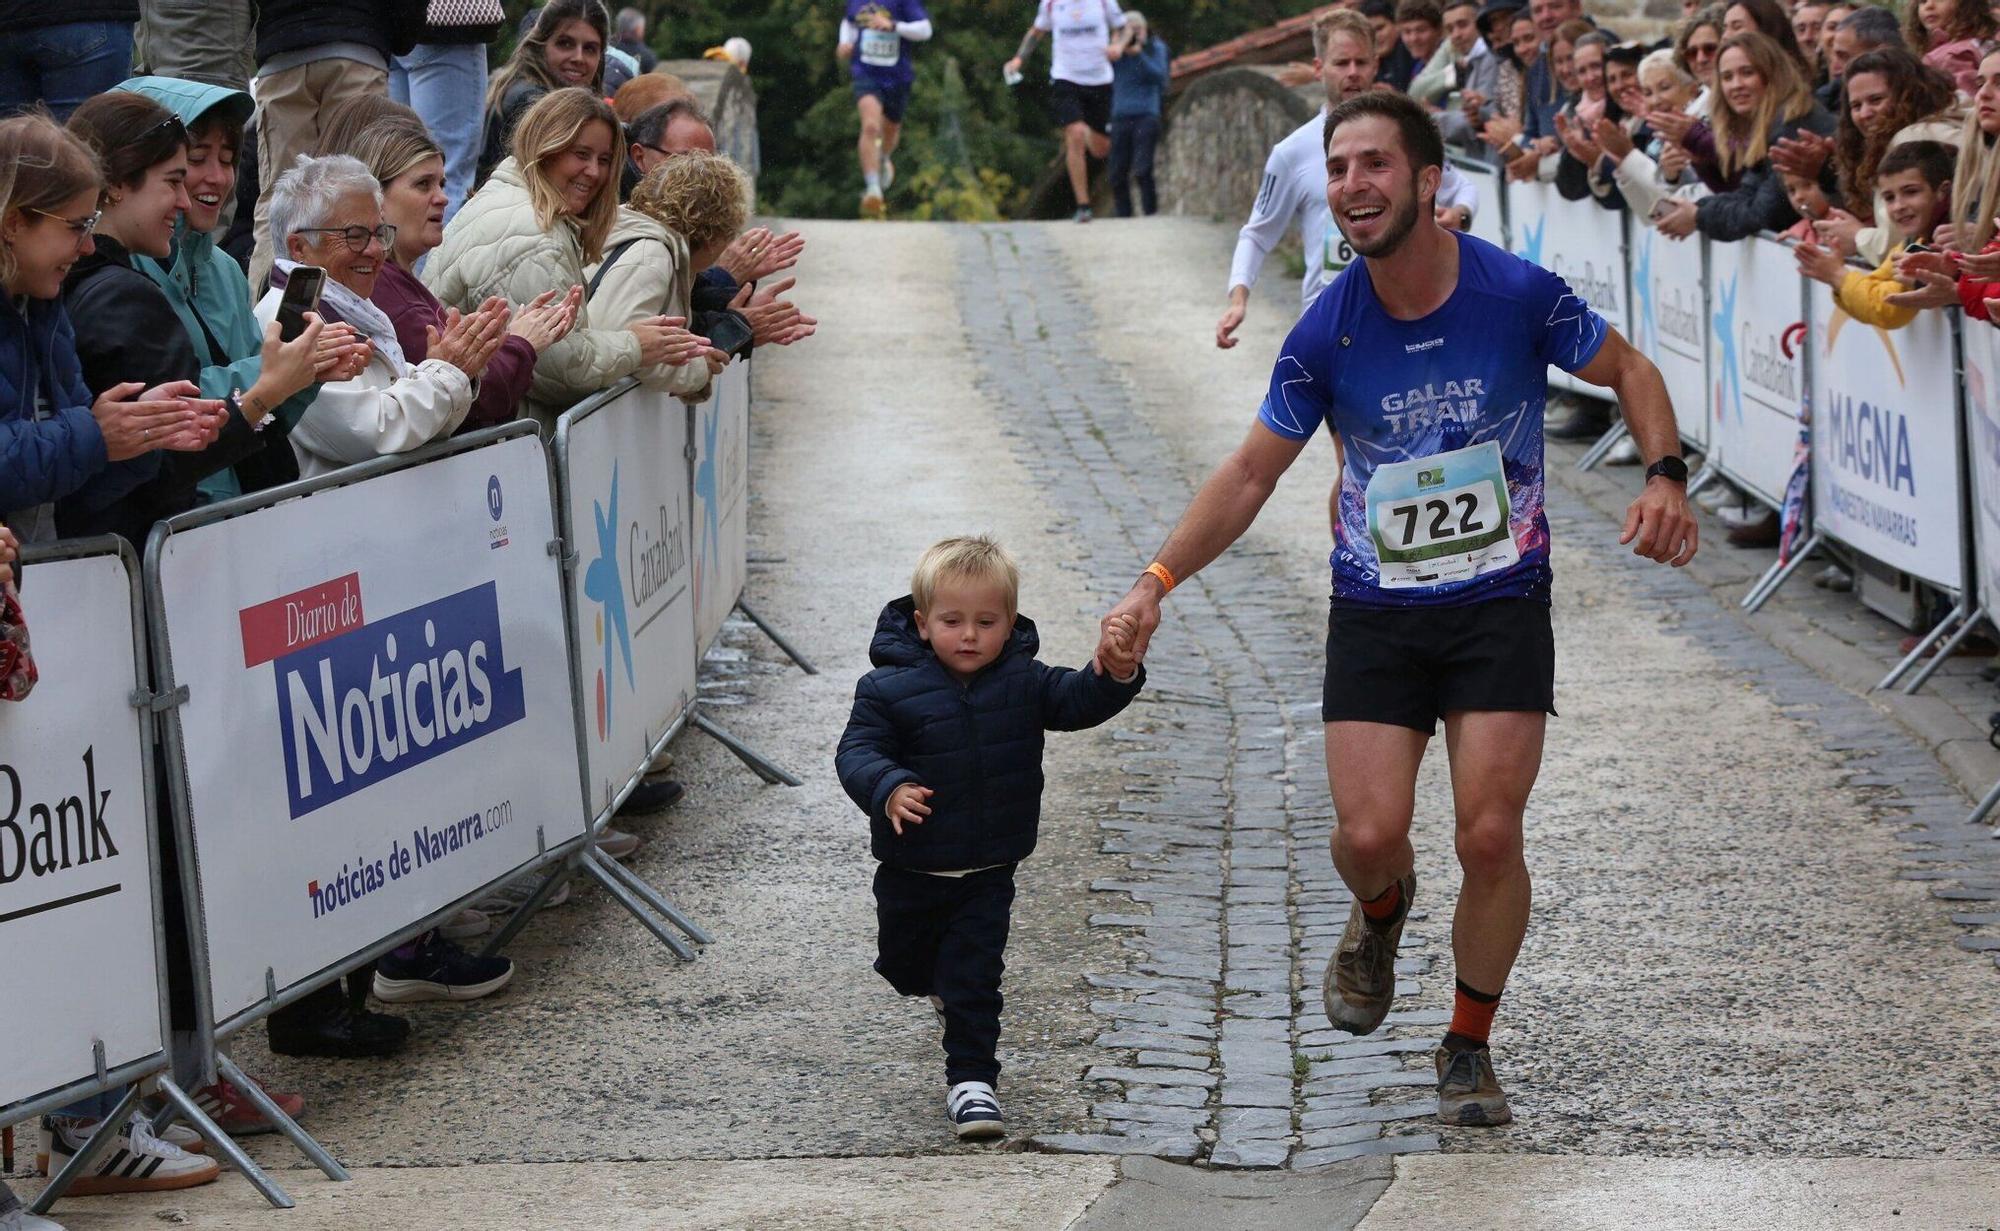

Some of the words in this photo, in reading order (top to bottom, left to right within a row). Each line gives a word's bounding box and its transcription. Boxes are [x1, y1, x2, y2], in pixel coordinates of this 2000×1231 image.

[1552, 253, 1618, 313] ixaBank
[1381, 378, 1486, 412] GALAR
[1382, 399, 1485, 435] TRAIL
[1829, 389, 1916, 498] MAGNA
[630, 493, 686, 608] CaixaBank
[1392, 493, 1484, 546] 722
[286, 594, 337, 647] Diario
[341, 581, 359, 628] de
[287, 619, 492, 799] Noticias
[311, 857, 384, 919] noticias
[389, 840, 411, 881] de
[413, 800, 513, 869] Navarra.com
